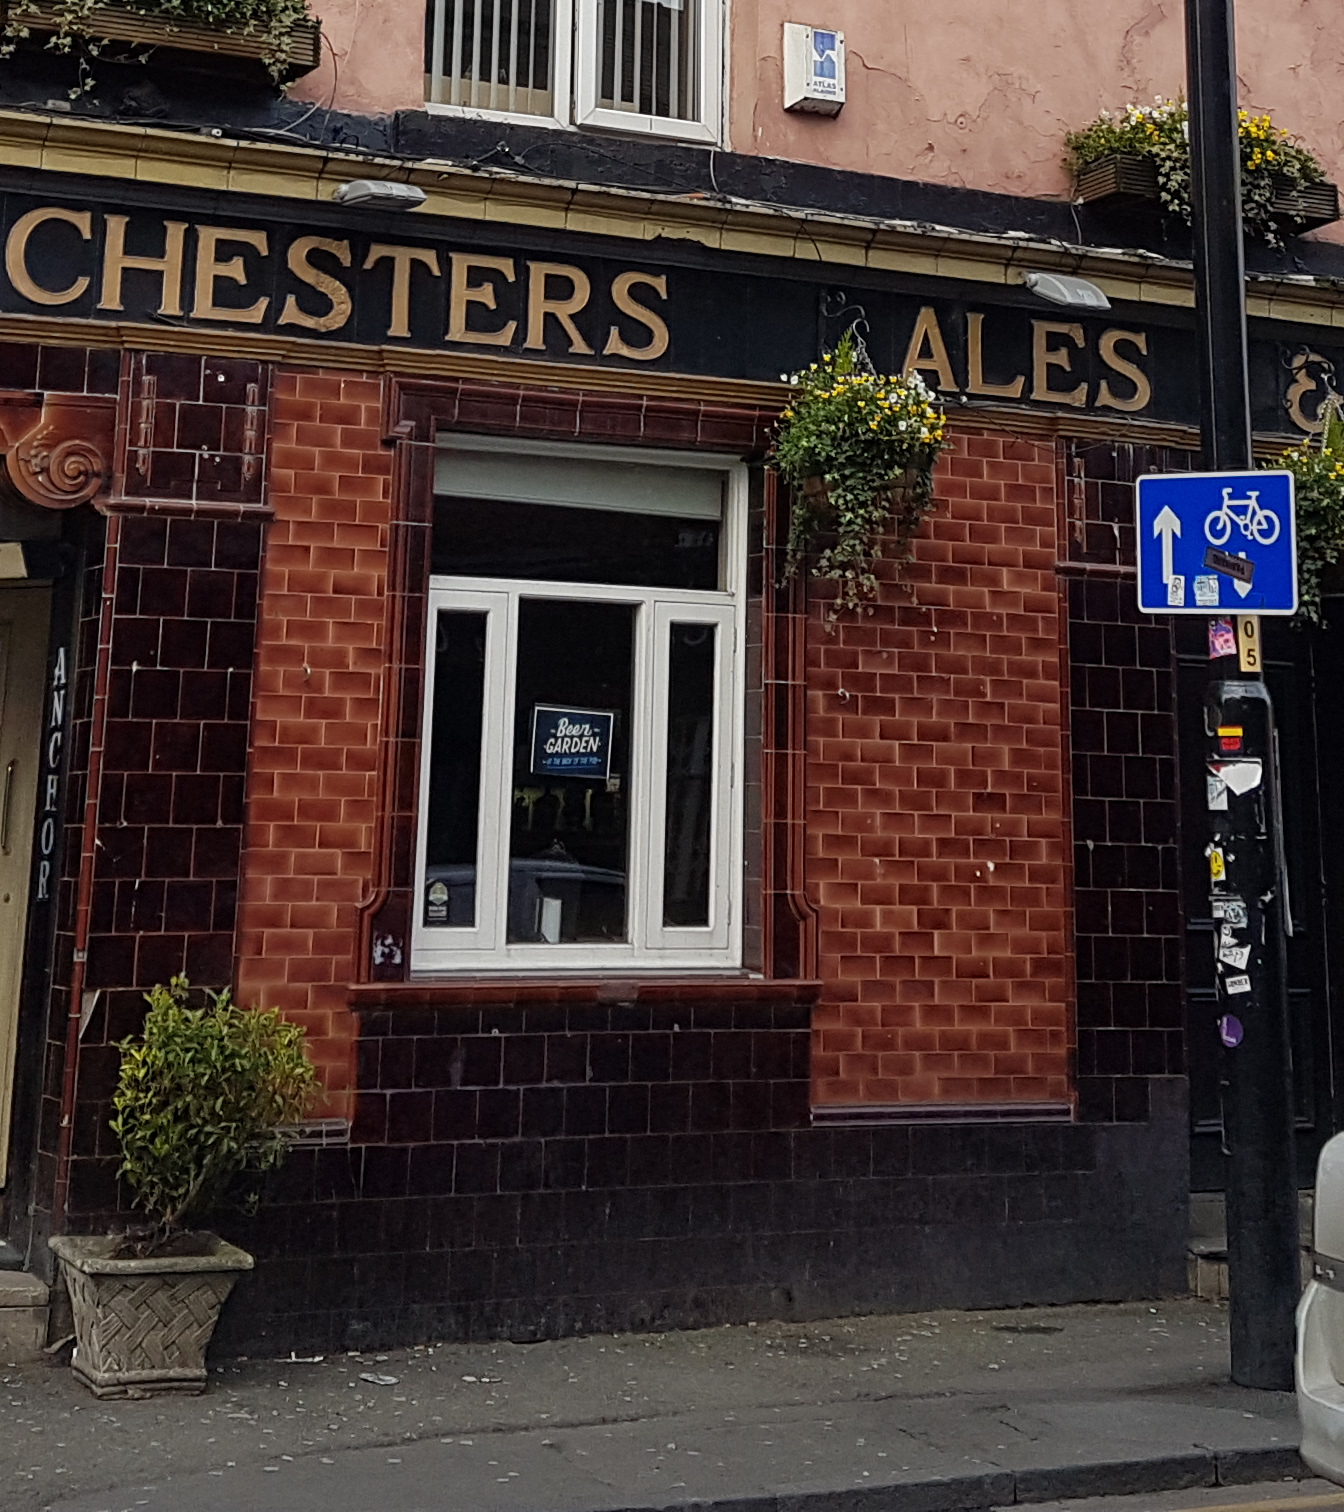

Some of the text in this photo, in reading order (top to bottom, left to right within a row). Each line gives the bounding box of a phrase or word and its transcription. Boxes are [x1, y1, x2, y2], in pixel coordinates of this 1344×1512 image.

[812, 80, 837, 90] ATLAS
[4, 205, 670, 362] CHESTERS
[900, 304, 1151, 413] ALES
[1285, 345, 1344, 434] &
[556, 717, 593, 737] Beer
[545, 736, 600, 754] GARDEN
[35, 646, 67, 902] ANCHOR
